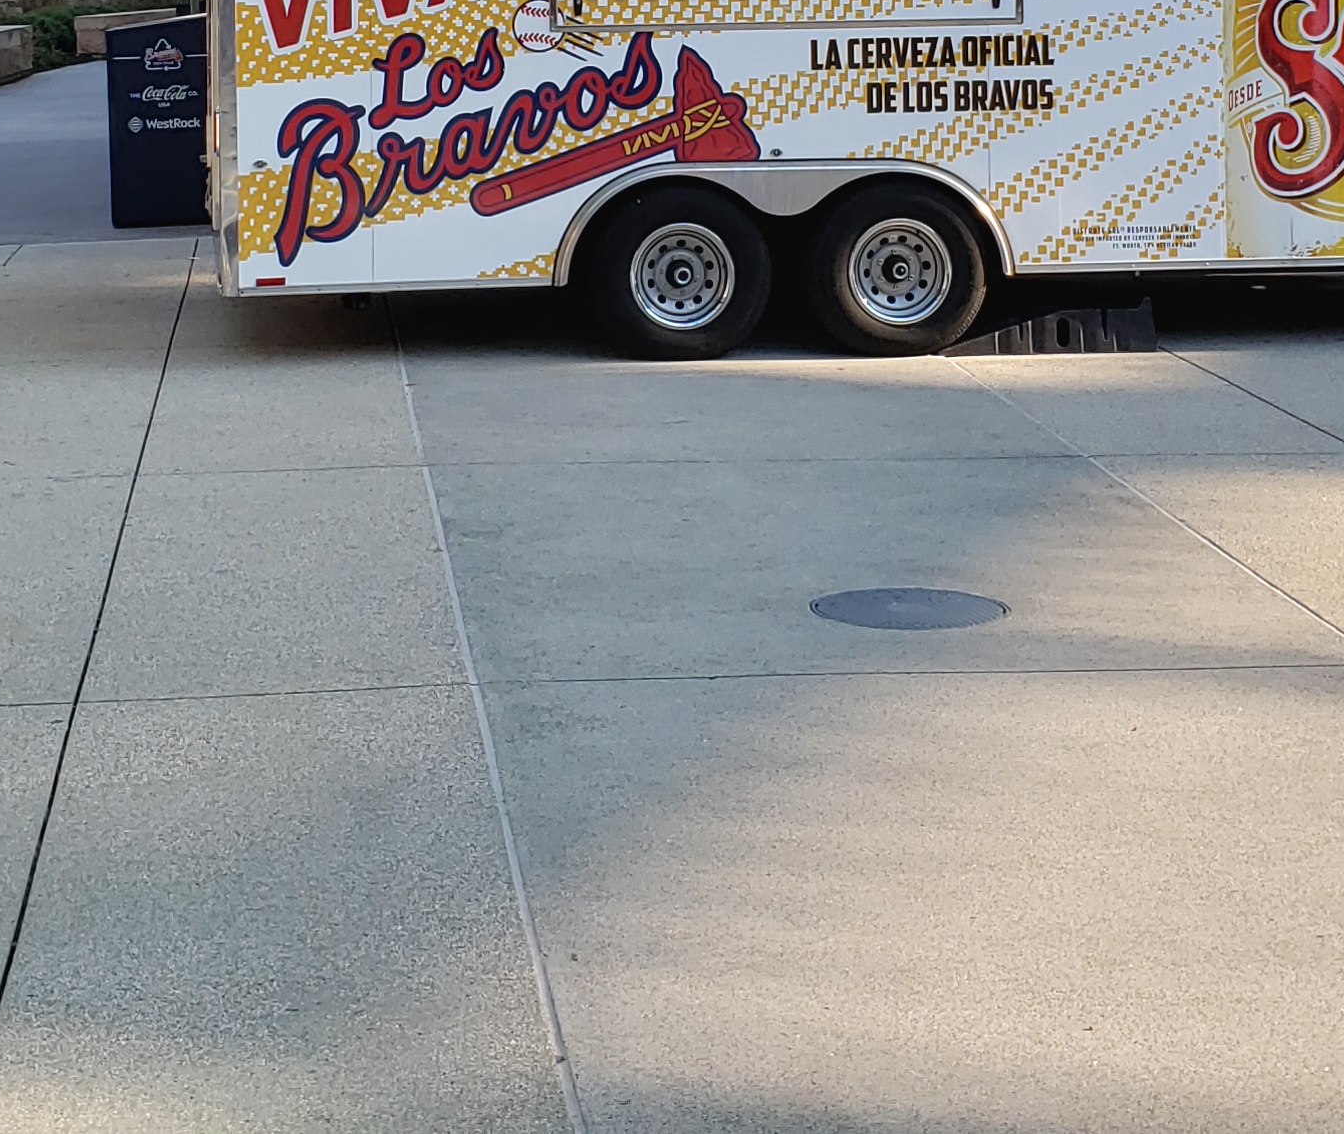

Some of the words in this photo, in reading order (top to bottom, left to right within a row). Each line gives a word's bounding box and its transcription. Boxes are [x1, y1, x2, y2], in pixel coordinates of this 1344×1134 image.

[809, 38, 844, 71] LA
[846, 36, 958, 70] CERVEZA
[961, 34, 1056, 68] OFICIAL
[367, 26, 506, 131] Los
[865, 81, 898, 115] DE
[902, 79, 949, 114] LOS
[953, 77, 1055, 113] BRAVOS
[1227, 78, 1264, 113] DESDE
[145, 116, 202, 130] WestRock
[272, 31, 664, 268] Bravos
